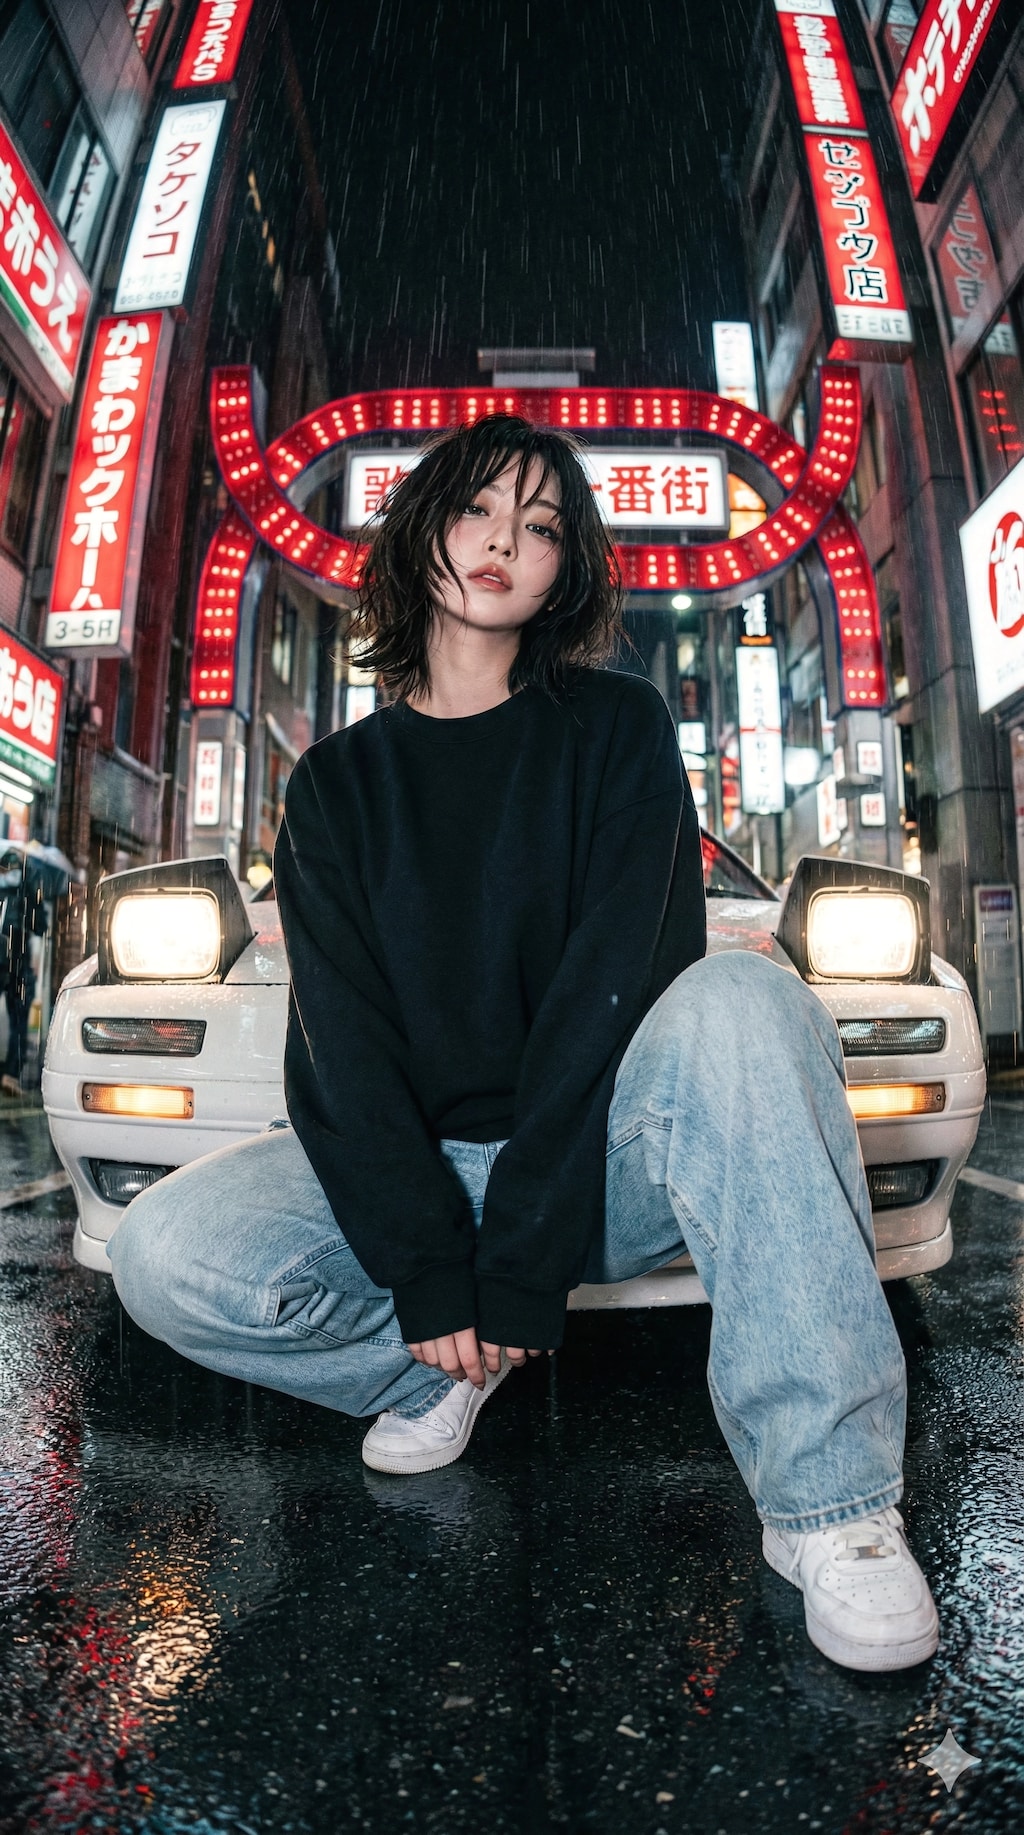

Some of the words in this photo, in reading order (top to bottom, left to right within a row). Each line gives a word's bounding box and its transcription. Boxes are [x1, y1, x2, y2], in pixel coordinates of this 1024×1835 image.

[901, 0, 977, 158] ホテ
[142, 140, 202, 259] タケソコ
[591, 465, 710, 515] 番街
